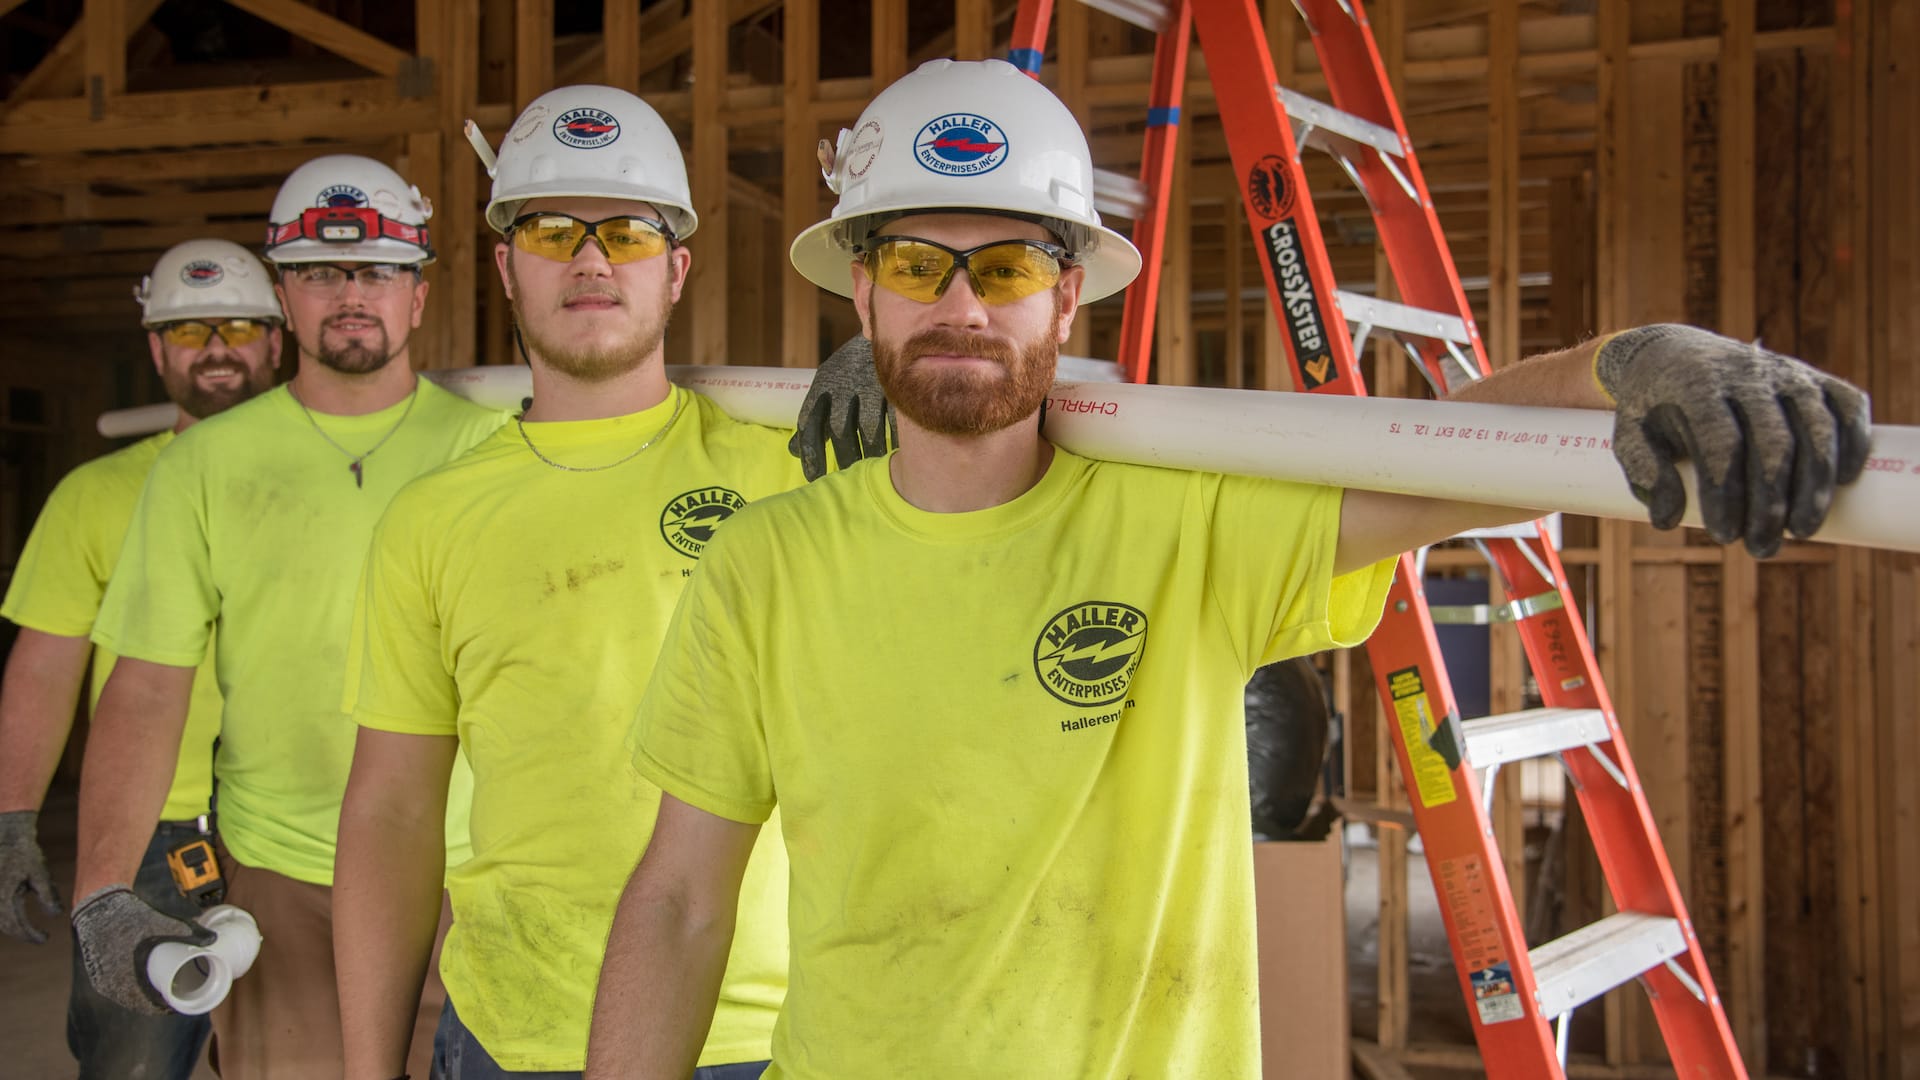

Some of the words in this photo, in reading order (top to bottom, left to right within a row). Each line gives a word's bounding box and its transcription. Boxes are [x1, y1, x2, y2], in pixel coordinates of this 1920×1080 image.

[561, 110, 612, 124] HALLER
[929, 117, 992, 135] HALLER
[1270, 222, 1322, 350] CROSSXSTEP
[1389, 423, 1401, 434] TS
[1436, 426, 1454, 437] EXT
[1496, 430, 1548, 444] 01/07/18
[1556, 434, 1596, 449] U.S.A.
[670, 491, 743, 518] HALLER
[672, 532, 705, 553] ENTER
[1045, 607, 1138, 648] HALLER
